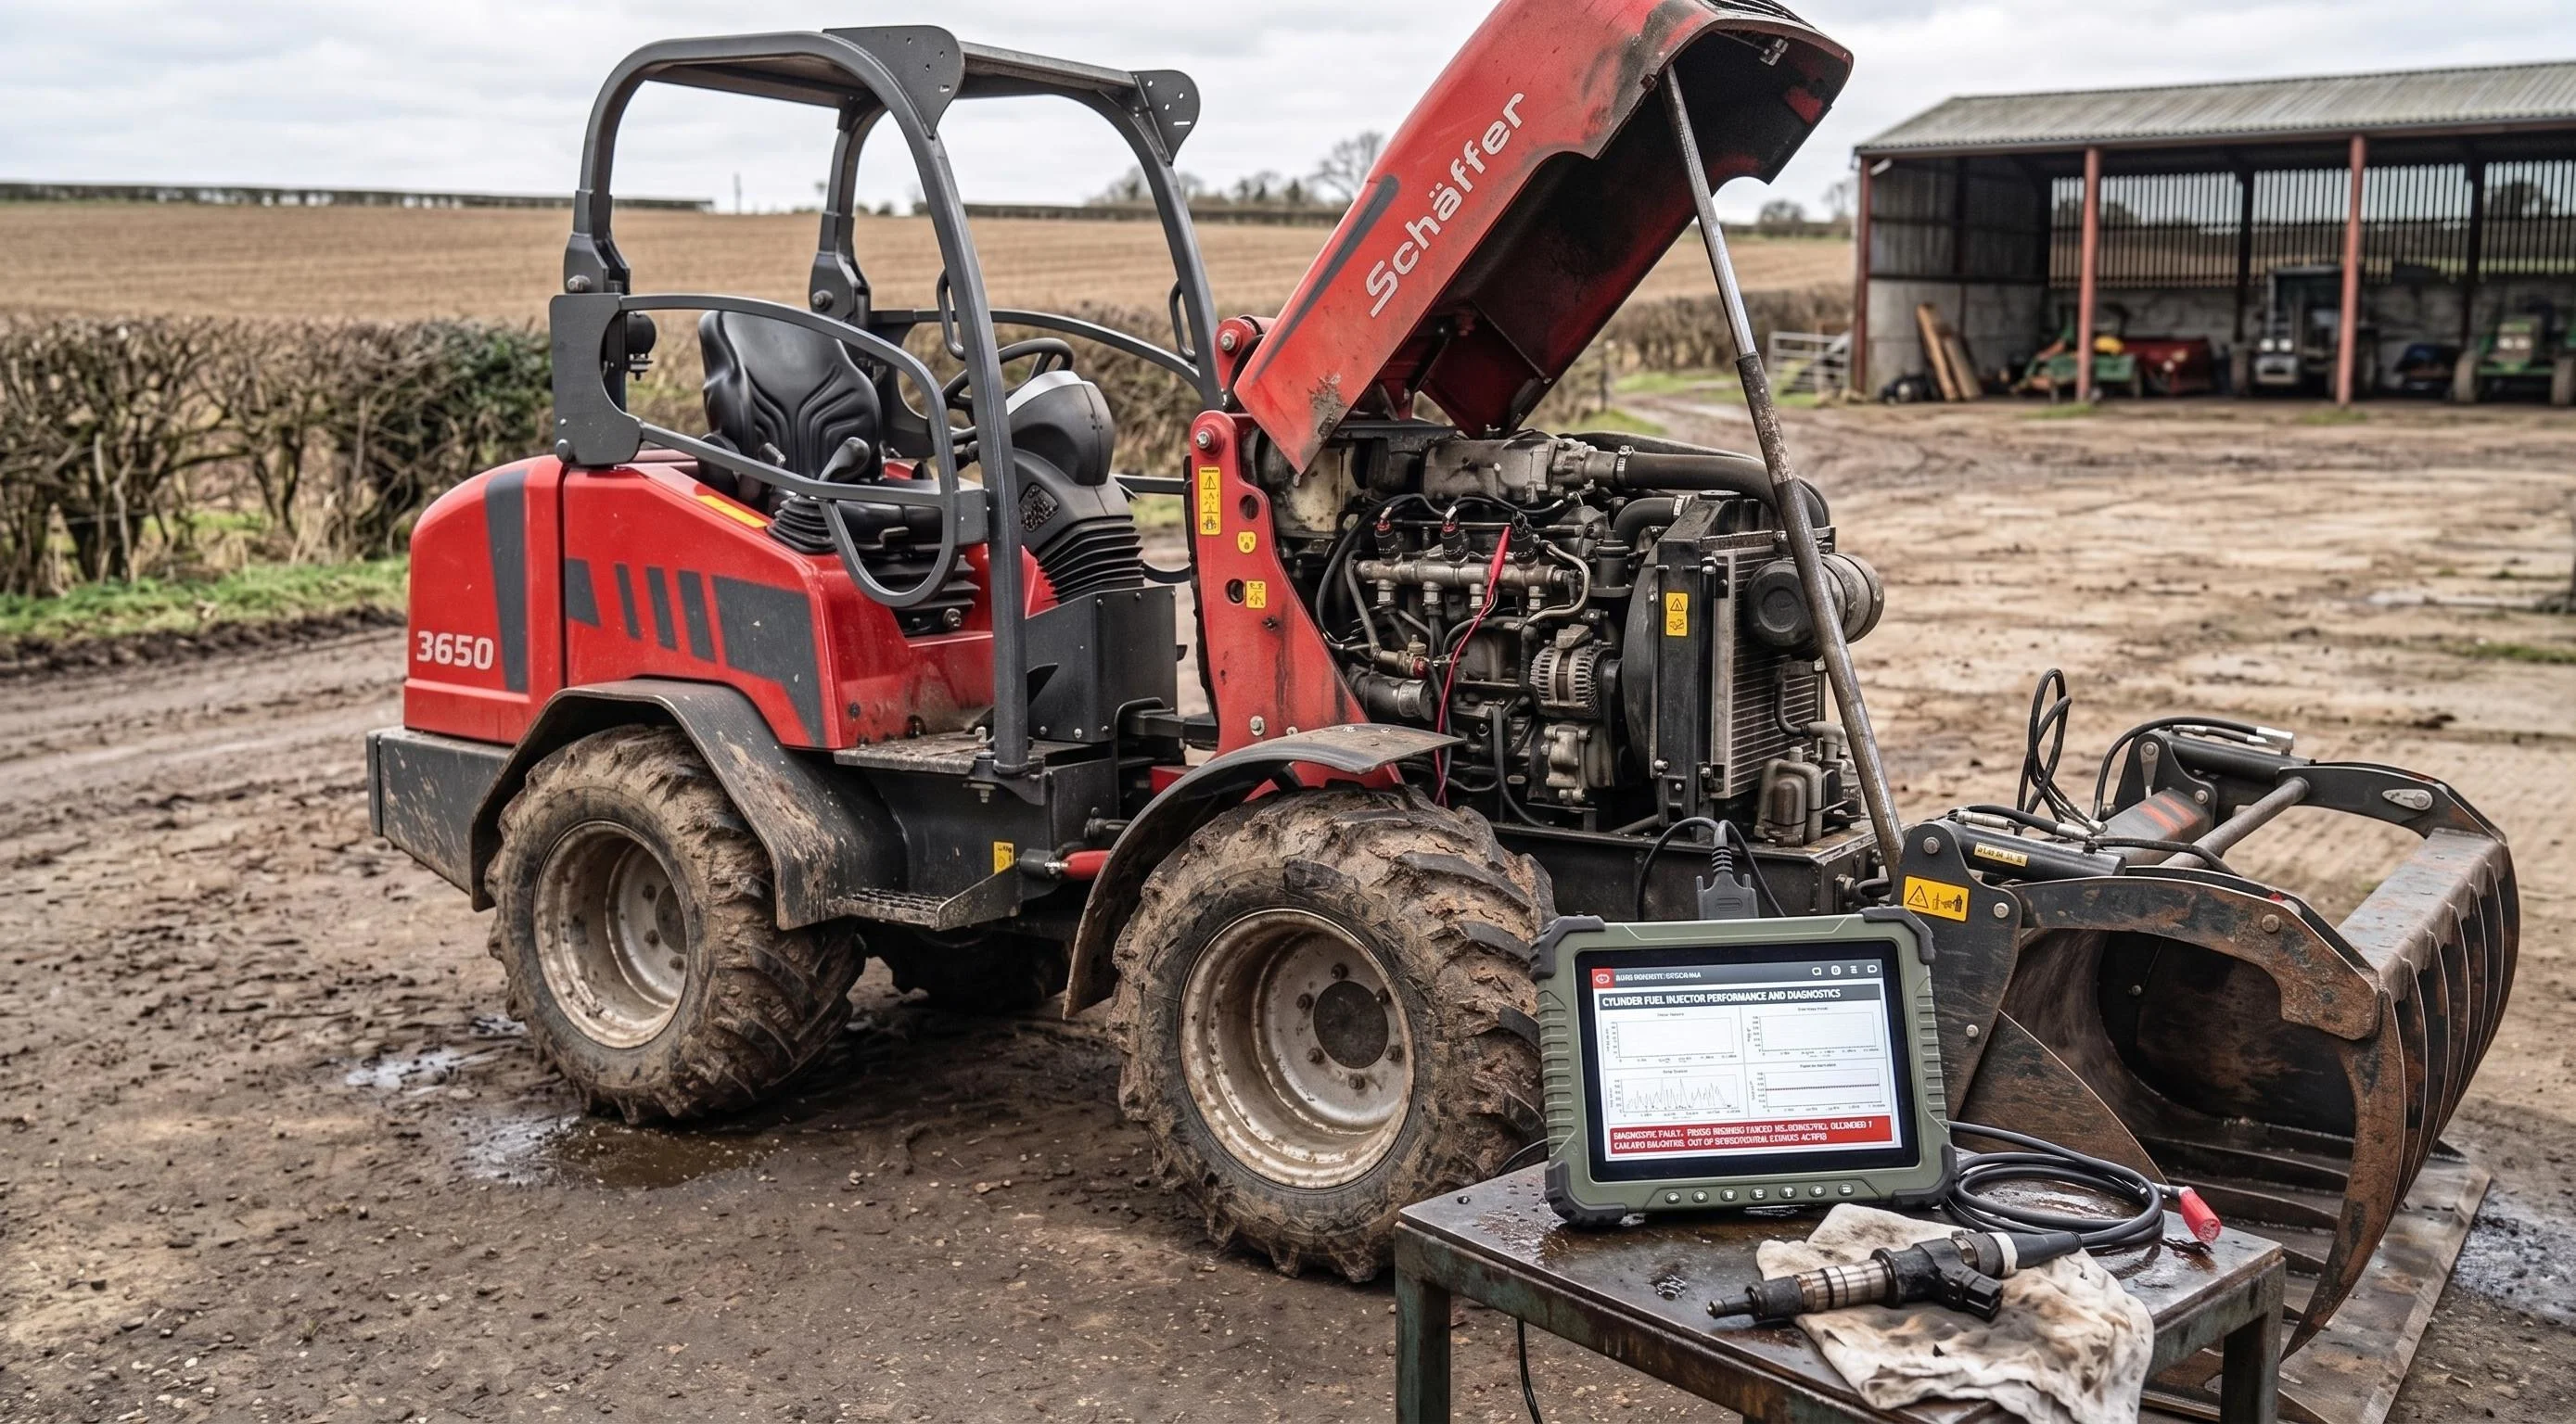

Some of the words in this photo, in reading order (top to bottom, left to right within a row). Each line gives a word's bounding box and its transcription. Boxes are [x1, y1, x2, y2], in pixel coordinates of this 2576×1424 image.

[1366, 93, 1525, 318] Schäffer
[416, 630, 494, 670] 3650
[1602, 996, 1642, 1007] CYLINDER
[1644, 995, 1664, 1005] FUEL
[1666, 994, 1705, 1004] INJECTOR
[1707, 991, 1766, 1003] PERFORMANCE
[1768, 991, 1786, 1000] AND
[1788, 988, 1841, 999] DIAGNOSTICS
